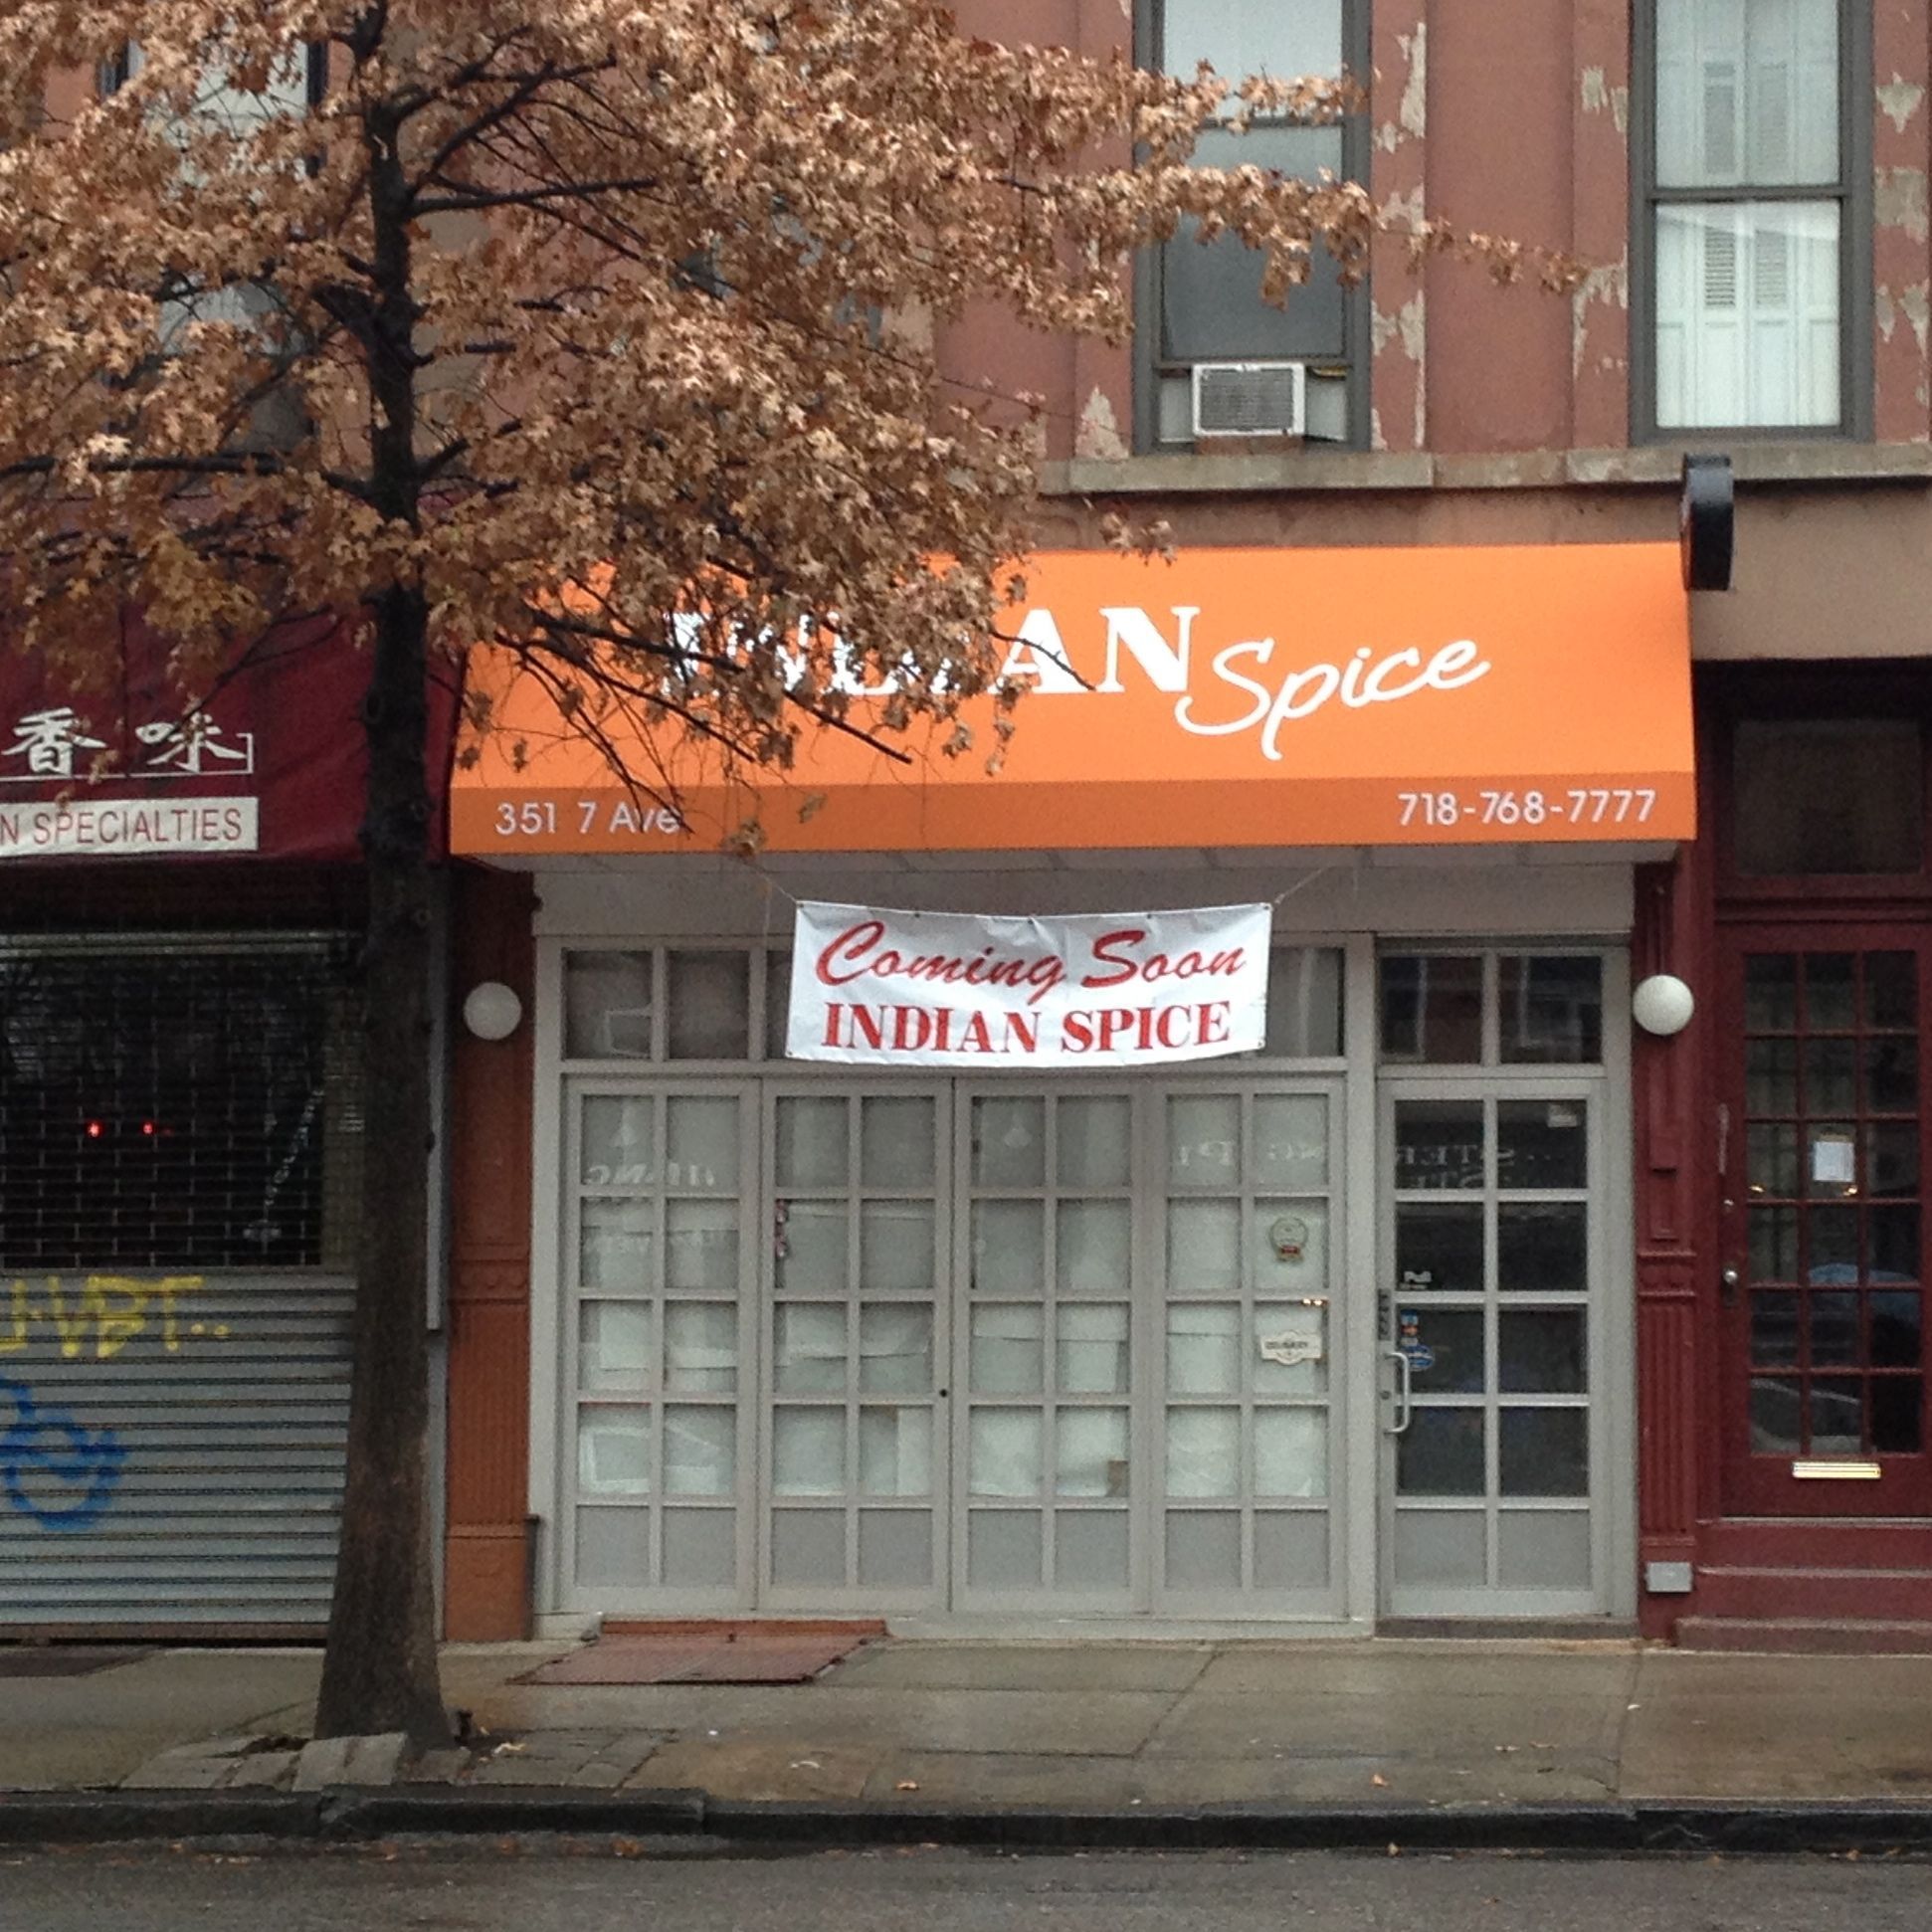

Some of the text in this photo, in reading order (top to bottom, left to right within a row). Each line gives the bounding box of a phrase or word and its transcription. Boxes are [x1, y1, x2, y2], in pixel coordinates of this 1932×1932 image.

[658, 606, 1492, 760] IAN Spice
[34, 808, 243, 845] SPECIALTIES
[494, 802, 680, 836] 351 7 Ave
[1397, 789, 1657, 827] 718-768-7777
[816, 920, 1247, 1005] Coming Soon
[821, 1000, 1230, 1053] INDIAN SPICE
